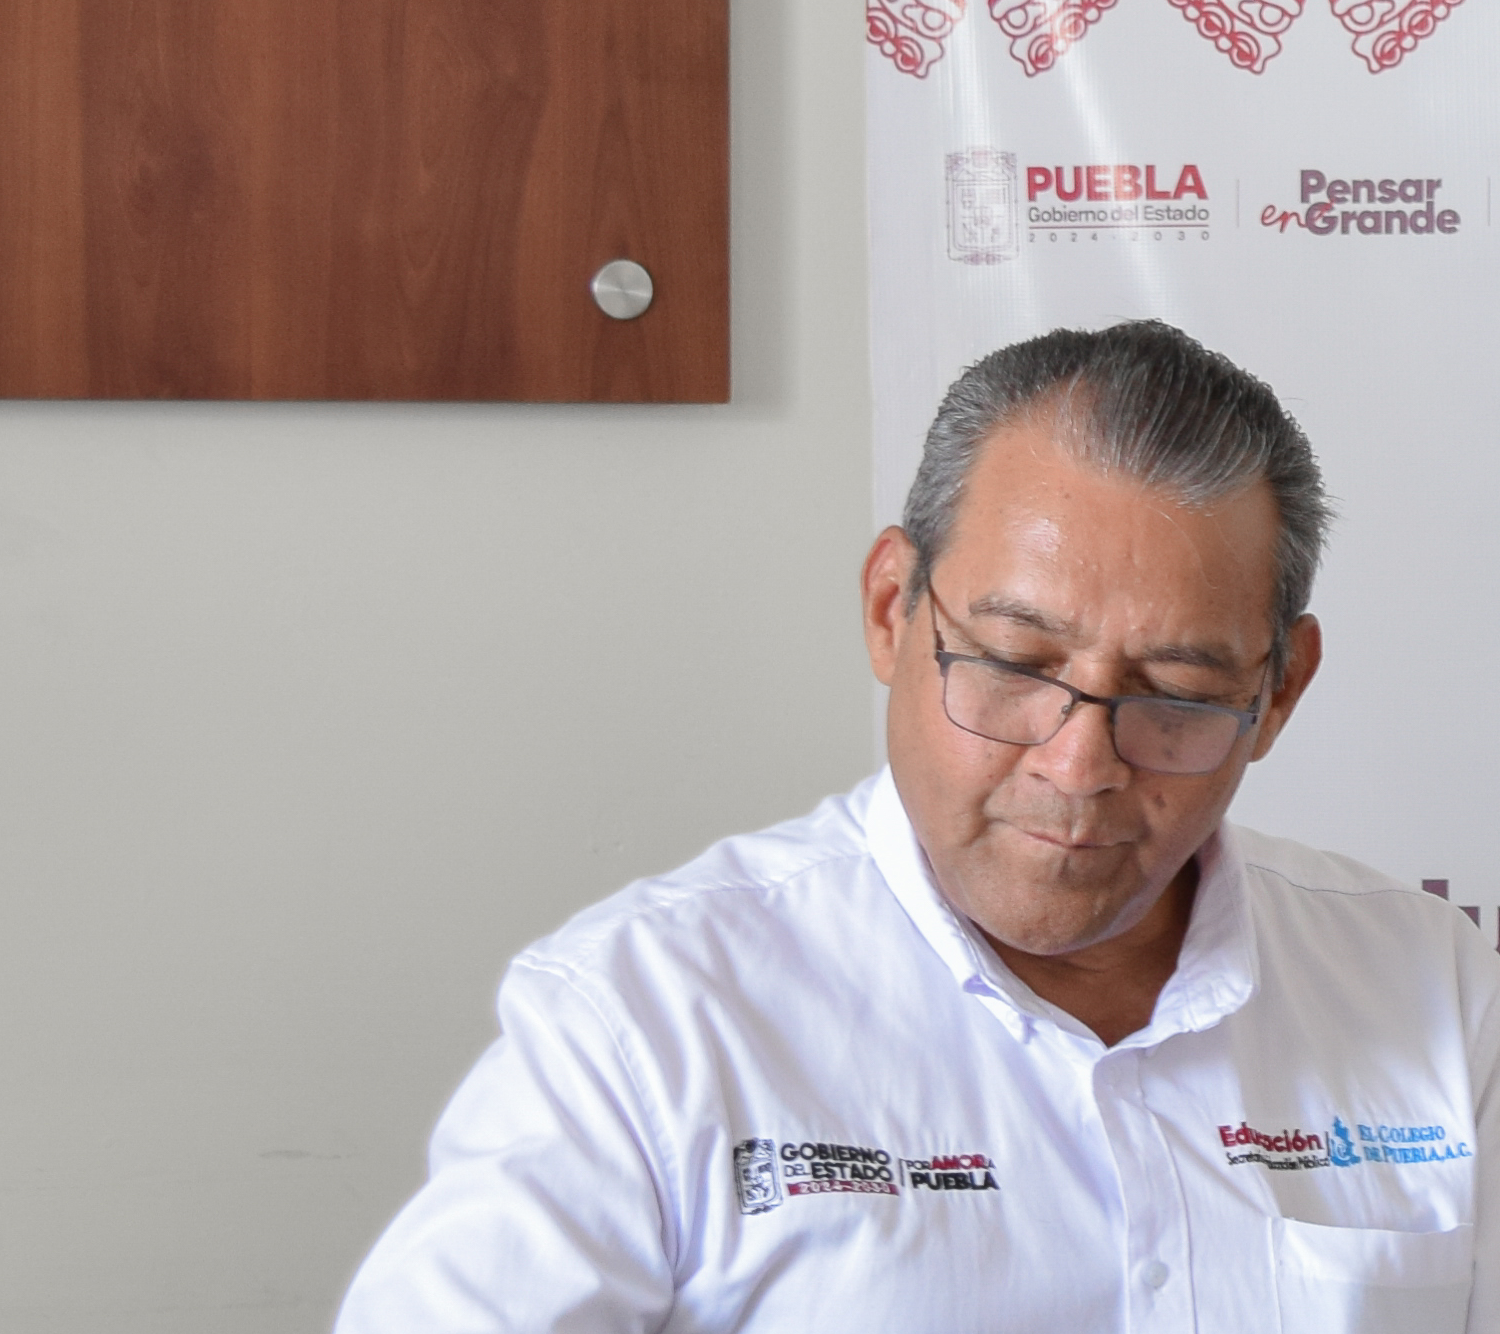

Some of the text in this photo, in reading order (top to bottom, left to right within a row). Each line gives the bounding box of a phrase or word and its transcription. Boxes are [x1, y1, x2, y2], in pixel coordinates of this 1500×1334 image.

[1026, 164, 1209, 202] PUEBLA
[1299, 169, 1442, 204] Pensar
[1028, 204, 1209, 223] Gobierno del Estado
[1306, 201, 1461, 236] Grande
[780, 1142, 890, 1165] GOBIERNO
[811, 1162, 893, 1182] ESTADO
[911, 1171, 1000, 1190] PUEBLA
